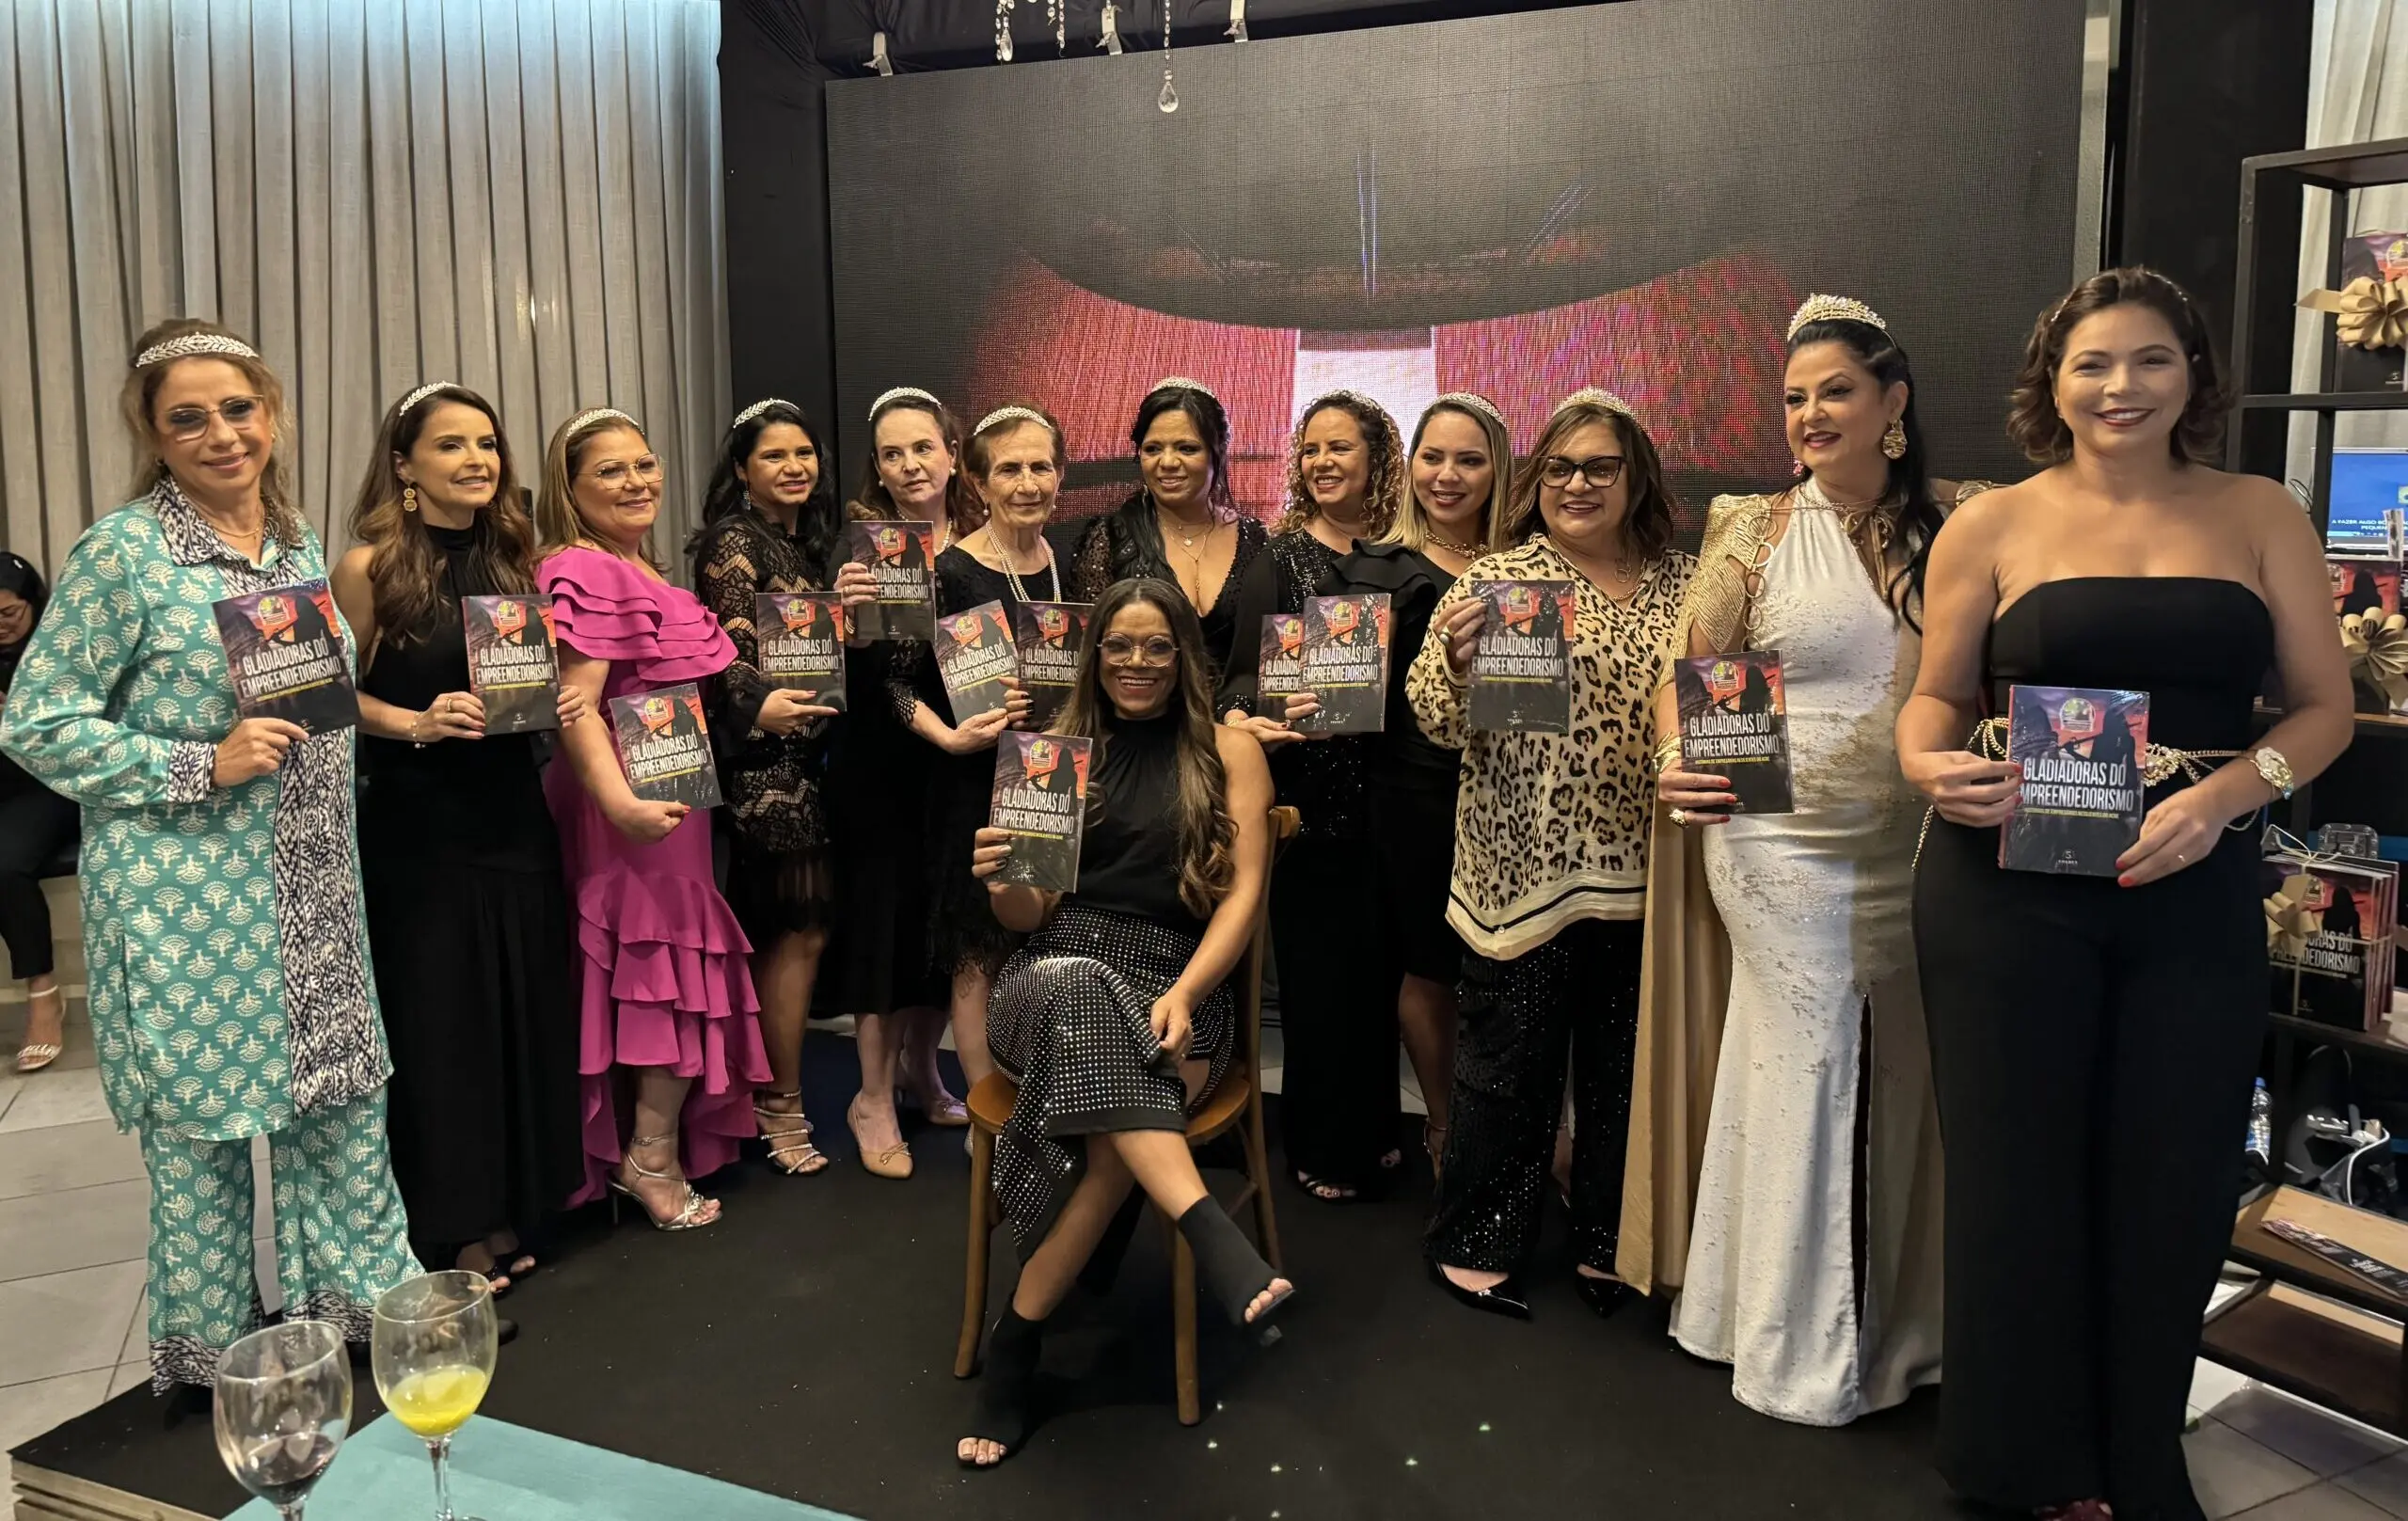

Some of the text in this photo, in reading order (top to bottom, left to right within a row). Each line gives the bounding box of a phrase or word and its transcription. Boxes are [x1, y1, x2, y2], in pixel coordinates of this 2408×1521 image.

[876, 584, 928, 598] ENDEDORISMO
[480, 645, 534, 666] GLADIADORAS
[768, 640, 820, 656] GLADIADORAS
[947, 644, 995, 673] GLADIADORAS
[1025, 649, 1072, 666] GLADIADORAS
[1309, 645, 1361, 665] GLADIADORAS
[1480, 637, 1543, 657] GLADIADORAS
[243, 642, 313, 676] GLADIADORAS
[763, 656, 839, 672] EMPREENDEDORISMO
[1472, 657, 1563, 677] EMPREENDEDORISMO
[240, 656, 341, 698] EMPREENDEDORISMO
[476, 663, 553, 685] EMPREENDEDORISMO
[946, 656, 1016, 689] EMPREENDEDORISMO
[1303, 664, 1378, 683] EMPREENDEDORISMO
[1689, 713, 1755, 737] GLADIADORAS
[631, 736, 687, 762] GLADIADORAS
[1684, 735, 1780, 758] EMPREENDEDORISMO
[629, 749, 707, 779] EMPREENDEDORISMO
[2023, 757, 2107, 786] GLADIADORAS
[1002, 786, 1057, 812] GLADIADORAS
[2020, 784, 2134, 812] MPREENDEDORISMO
[993, 807, 1074, 834] EMPREENDEDORISMO
